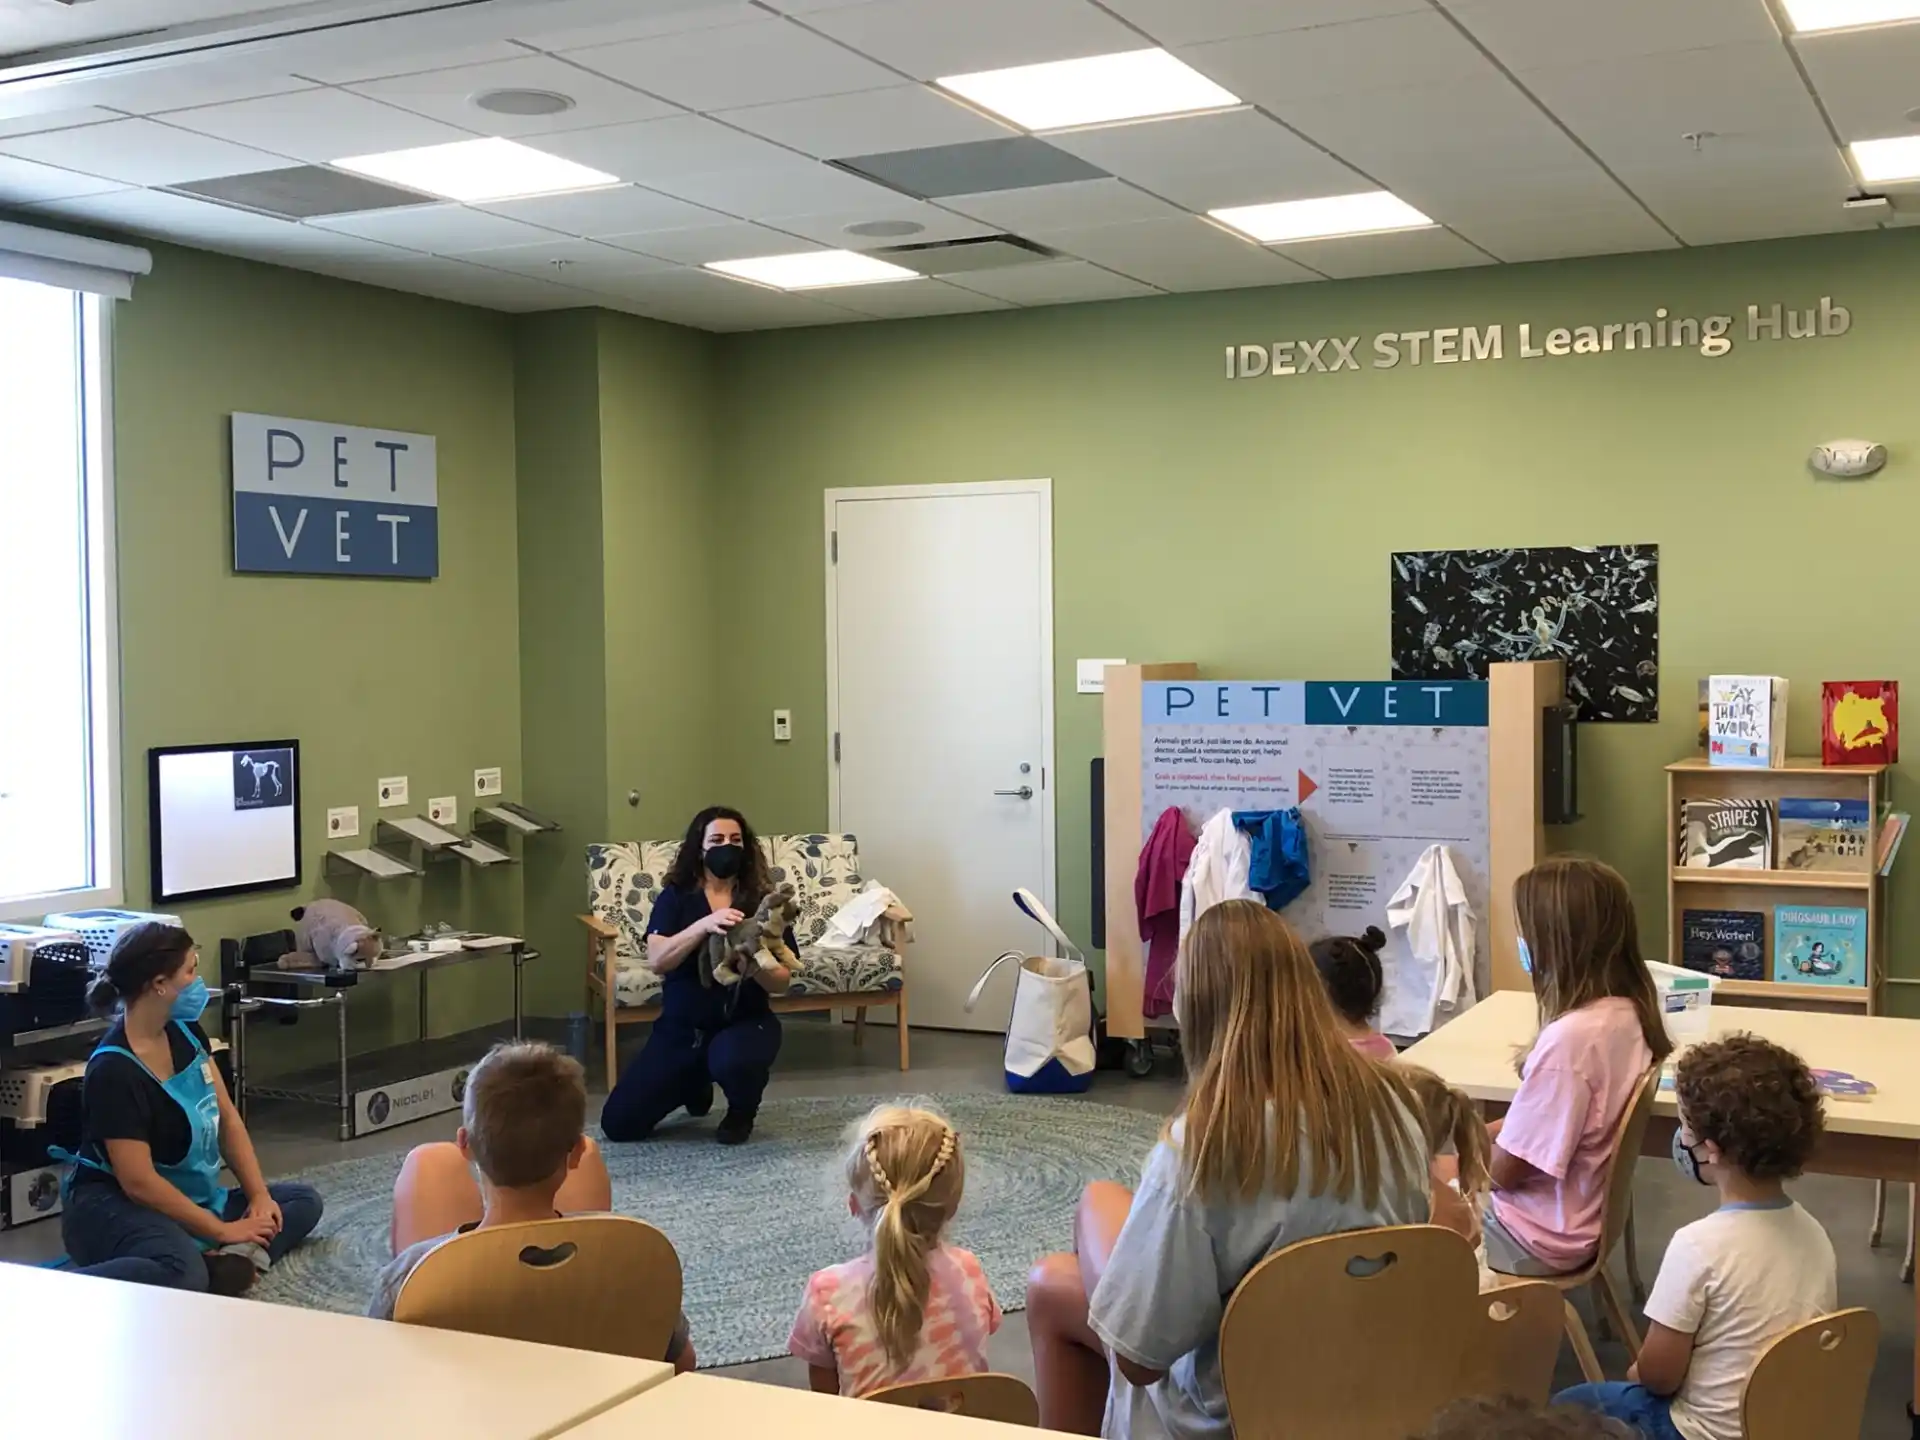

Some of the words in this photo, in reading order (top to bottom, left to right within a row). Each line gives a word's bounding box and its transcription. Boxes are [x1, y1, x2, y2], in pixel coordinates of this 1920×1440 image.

[1225, 335, 1361, 380] IDEXX
[1372, 323, 1504, 369] STEM
[1519, 308, 1733, 357] Learning
[1747, 296, 1852, 341] Hub
[267, 429, 409, 492] PET
[268, 505, 411, 565] VET
[1166, 687, 1281, 717] PET
[1328, 686, 1453, 718] VET
[1715, 720, 1764, 739] WORK
[1707, 809, 1759, 830] STRIPES
